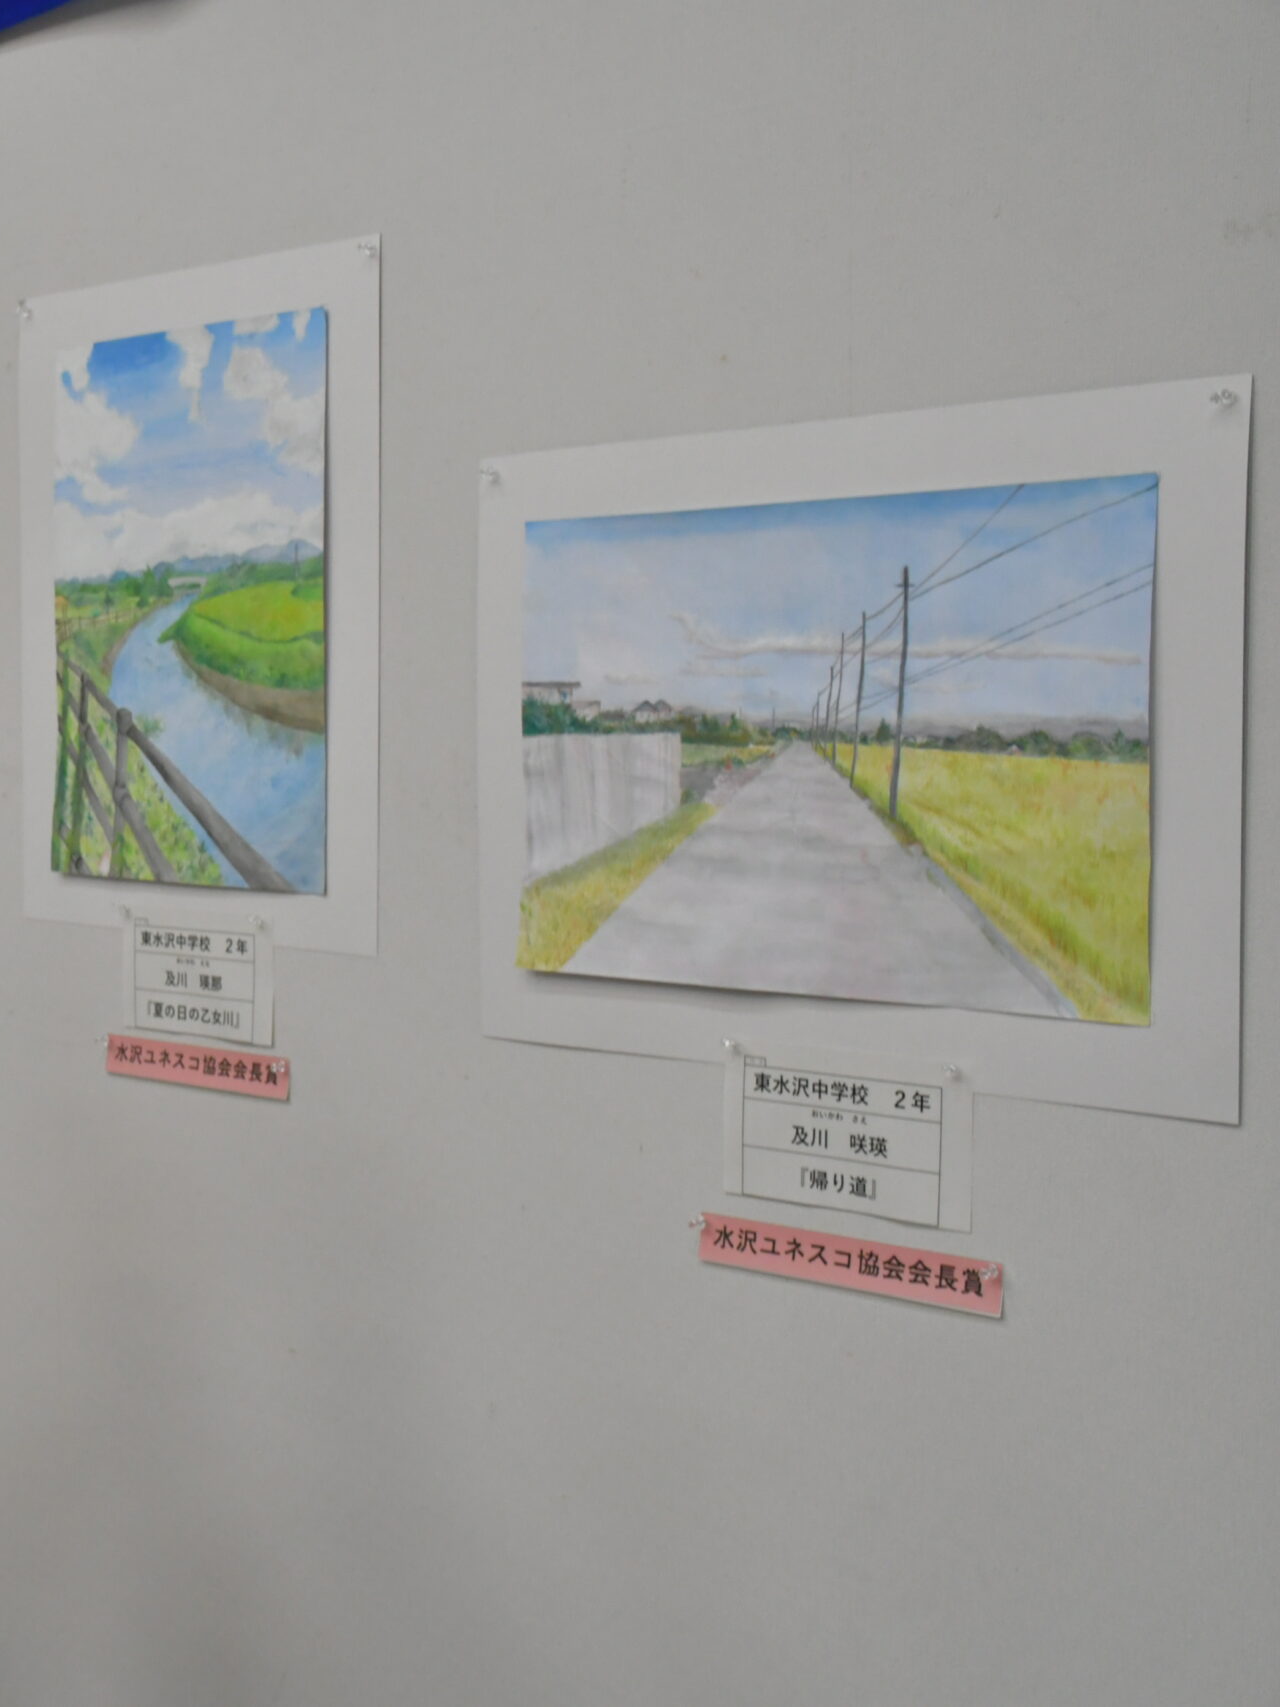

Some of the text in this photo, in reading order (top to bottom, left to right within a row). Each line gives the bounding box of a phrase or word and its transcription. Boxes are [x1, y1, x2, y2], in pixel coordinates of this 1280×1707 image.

[140, 931, 248, 955] 東水沢中学校 2年
[165, 970, 188, 989] 及川
[754, 1072, 931, 1113] 東水沢中学校 2年
[791, 1124, 888, 1159] 及川 咲瑛
[713, 1225, 984, 1298] 水沢ユネスコ協会会長賞
